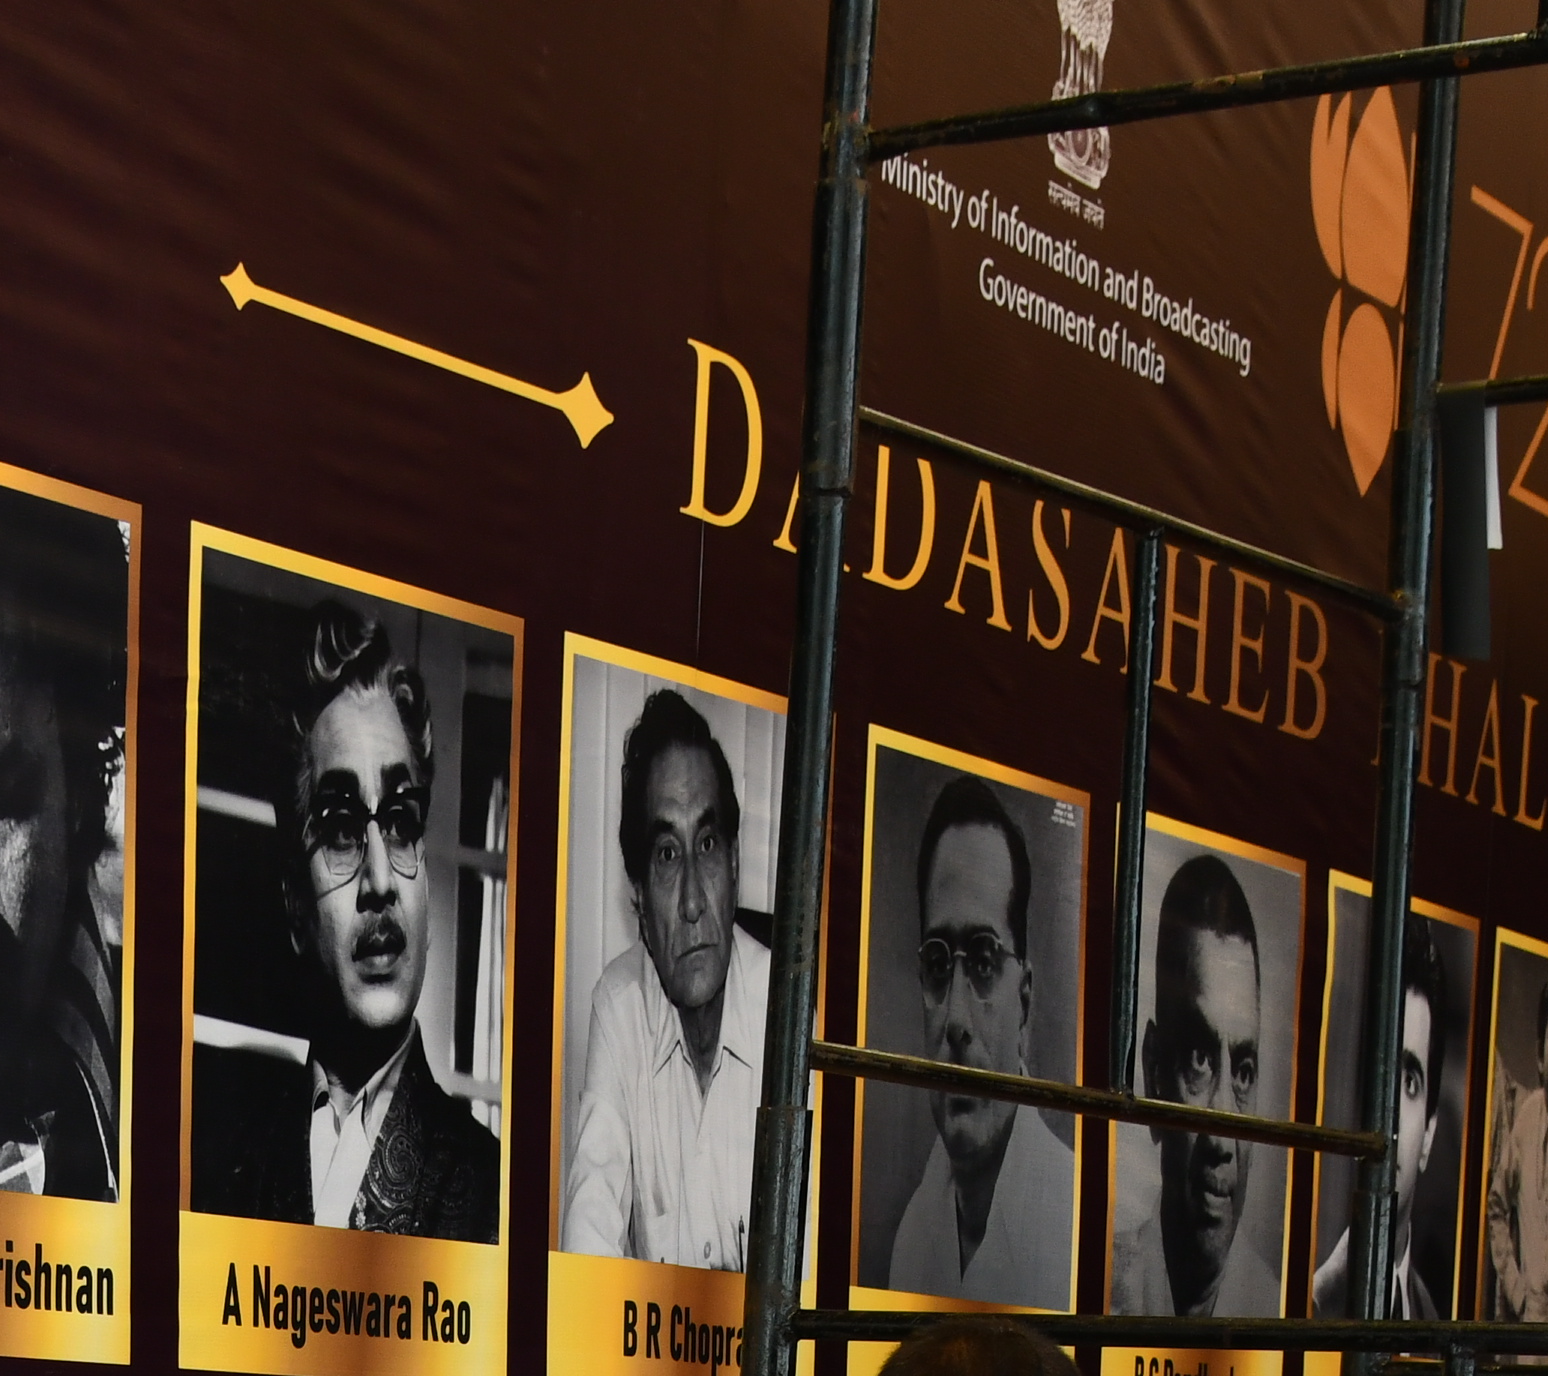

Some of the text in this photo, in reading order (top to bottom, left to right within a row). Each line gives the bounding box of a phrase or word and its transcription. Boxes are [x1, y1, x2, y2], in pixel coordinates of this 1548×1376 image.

[881, 152, 1252, 377] Ministry of Information and Broadcasting
[979, 257, 1165, 385] Government of India
[679, 337, 1328, 742] DDASAHEB
[222, 1263, 470, 1349] A Nageswara Rao
[624, 1301, 637, 1356] B
[646, 1302, 661, 1359] R
